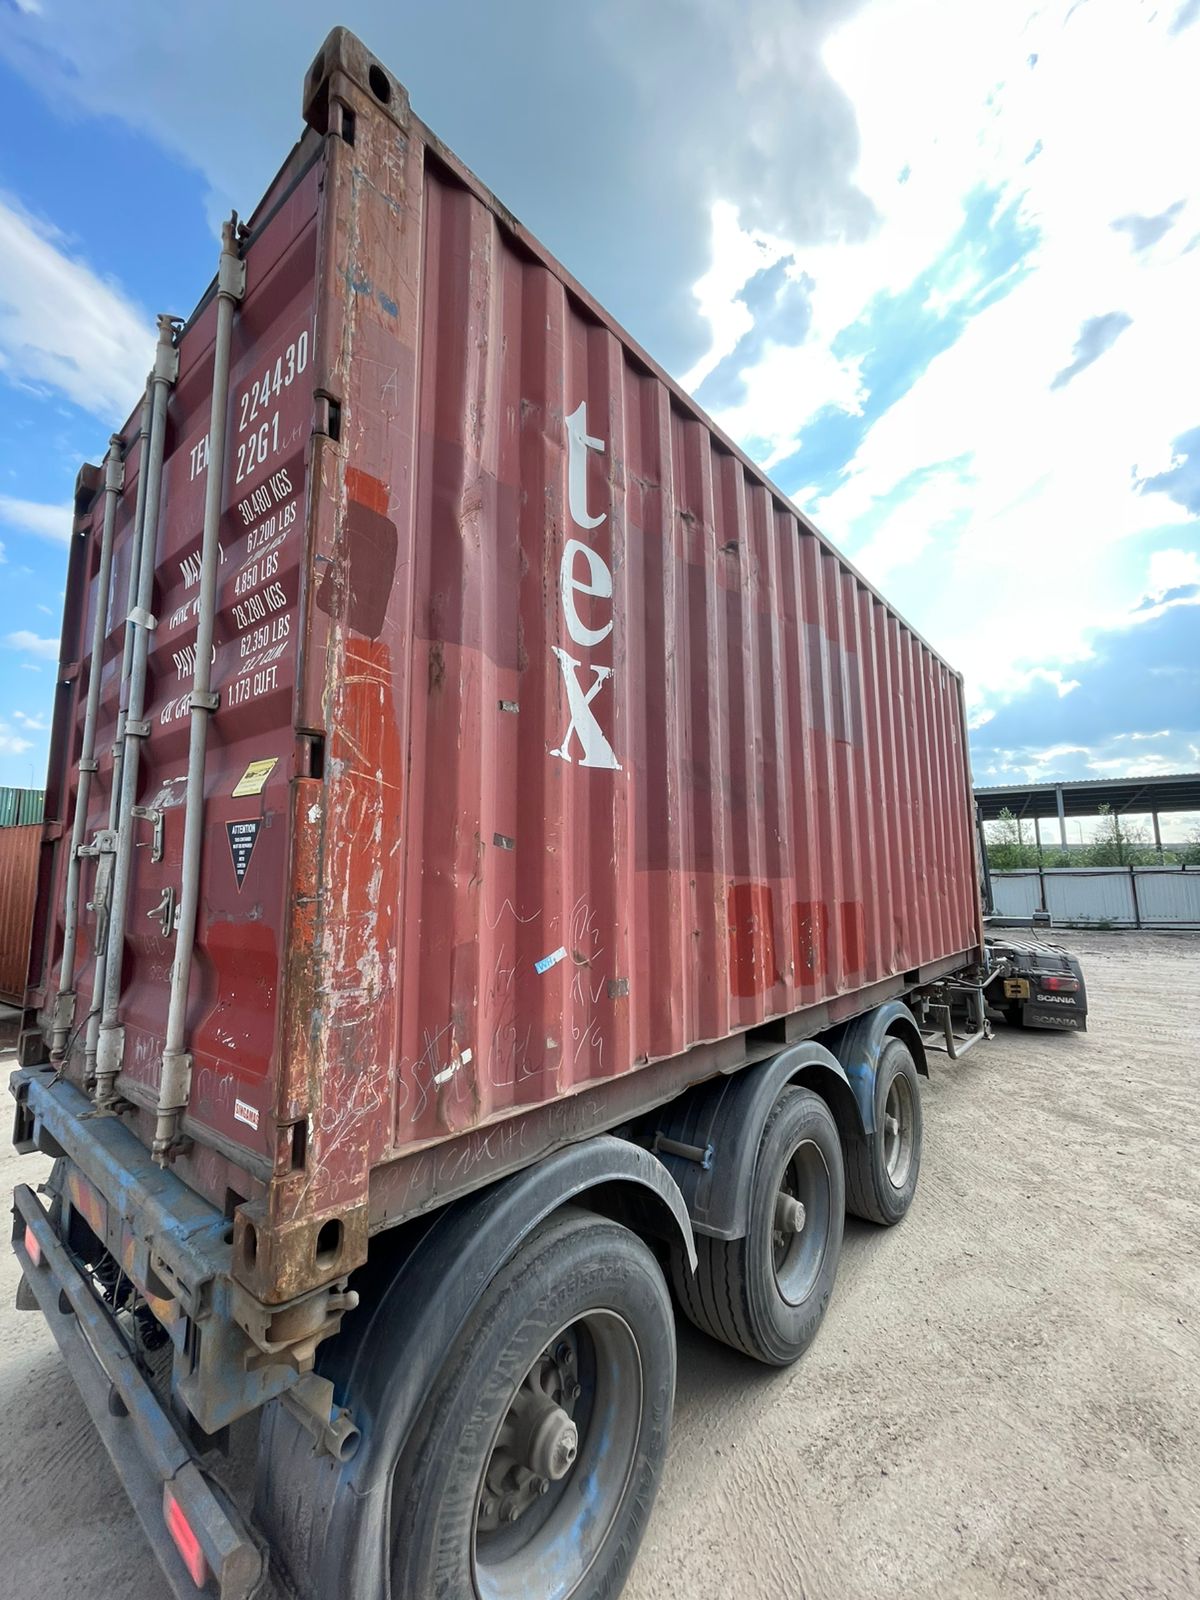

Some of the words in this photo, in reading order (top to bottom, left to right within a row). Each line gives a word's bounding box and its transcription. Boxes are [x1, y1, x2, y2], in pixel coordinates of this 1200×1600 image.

[239, 331, 308, 433] 224430
[235, 410, 280, 484] 22G1
[238, 484, 272, 525] 30.480
[269, 468, 293, 502] KGS
[247, 516, 276, 553] 67.200
[278, 501, 297, 531] LBS
[234, 564, 258, 596] 4.850
[260, 551, 279, 581] LBS
[550, 400, 623, 770] tex
[232, 594, 266, 630] 28.280
[263, 581, 287, 612] KGS
[240, 625, 270, 658] 62.350
[272, 614, 291, 643] LBS
[228, 677, 251, 707] 1.173
[231, 823, 256, 835] ATTENTION
[1031, 1014, 1078, 1028] SCANIA
[1036, 994, 1076, 1005] SCANIA
